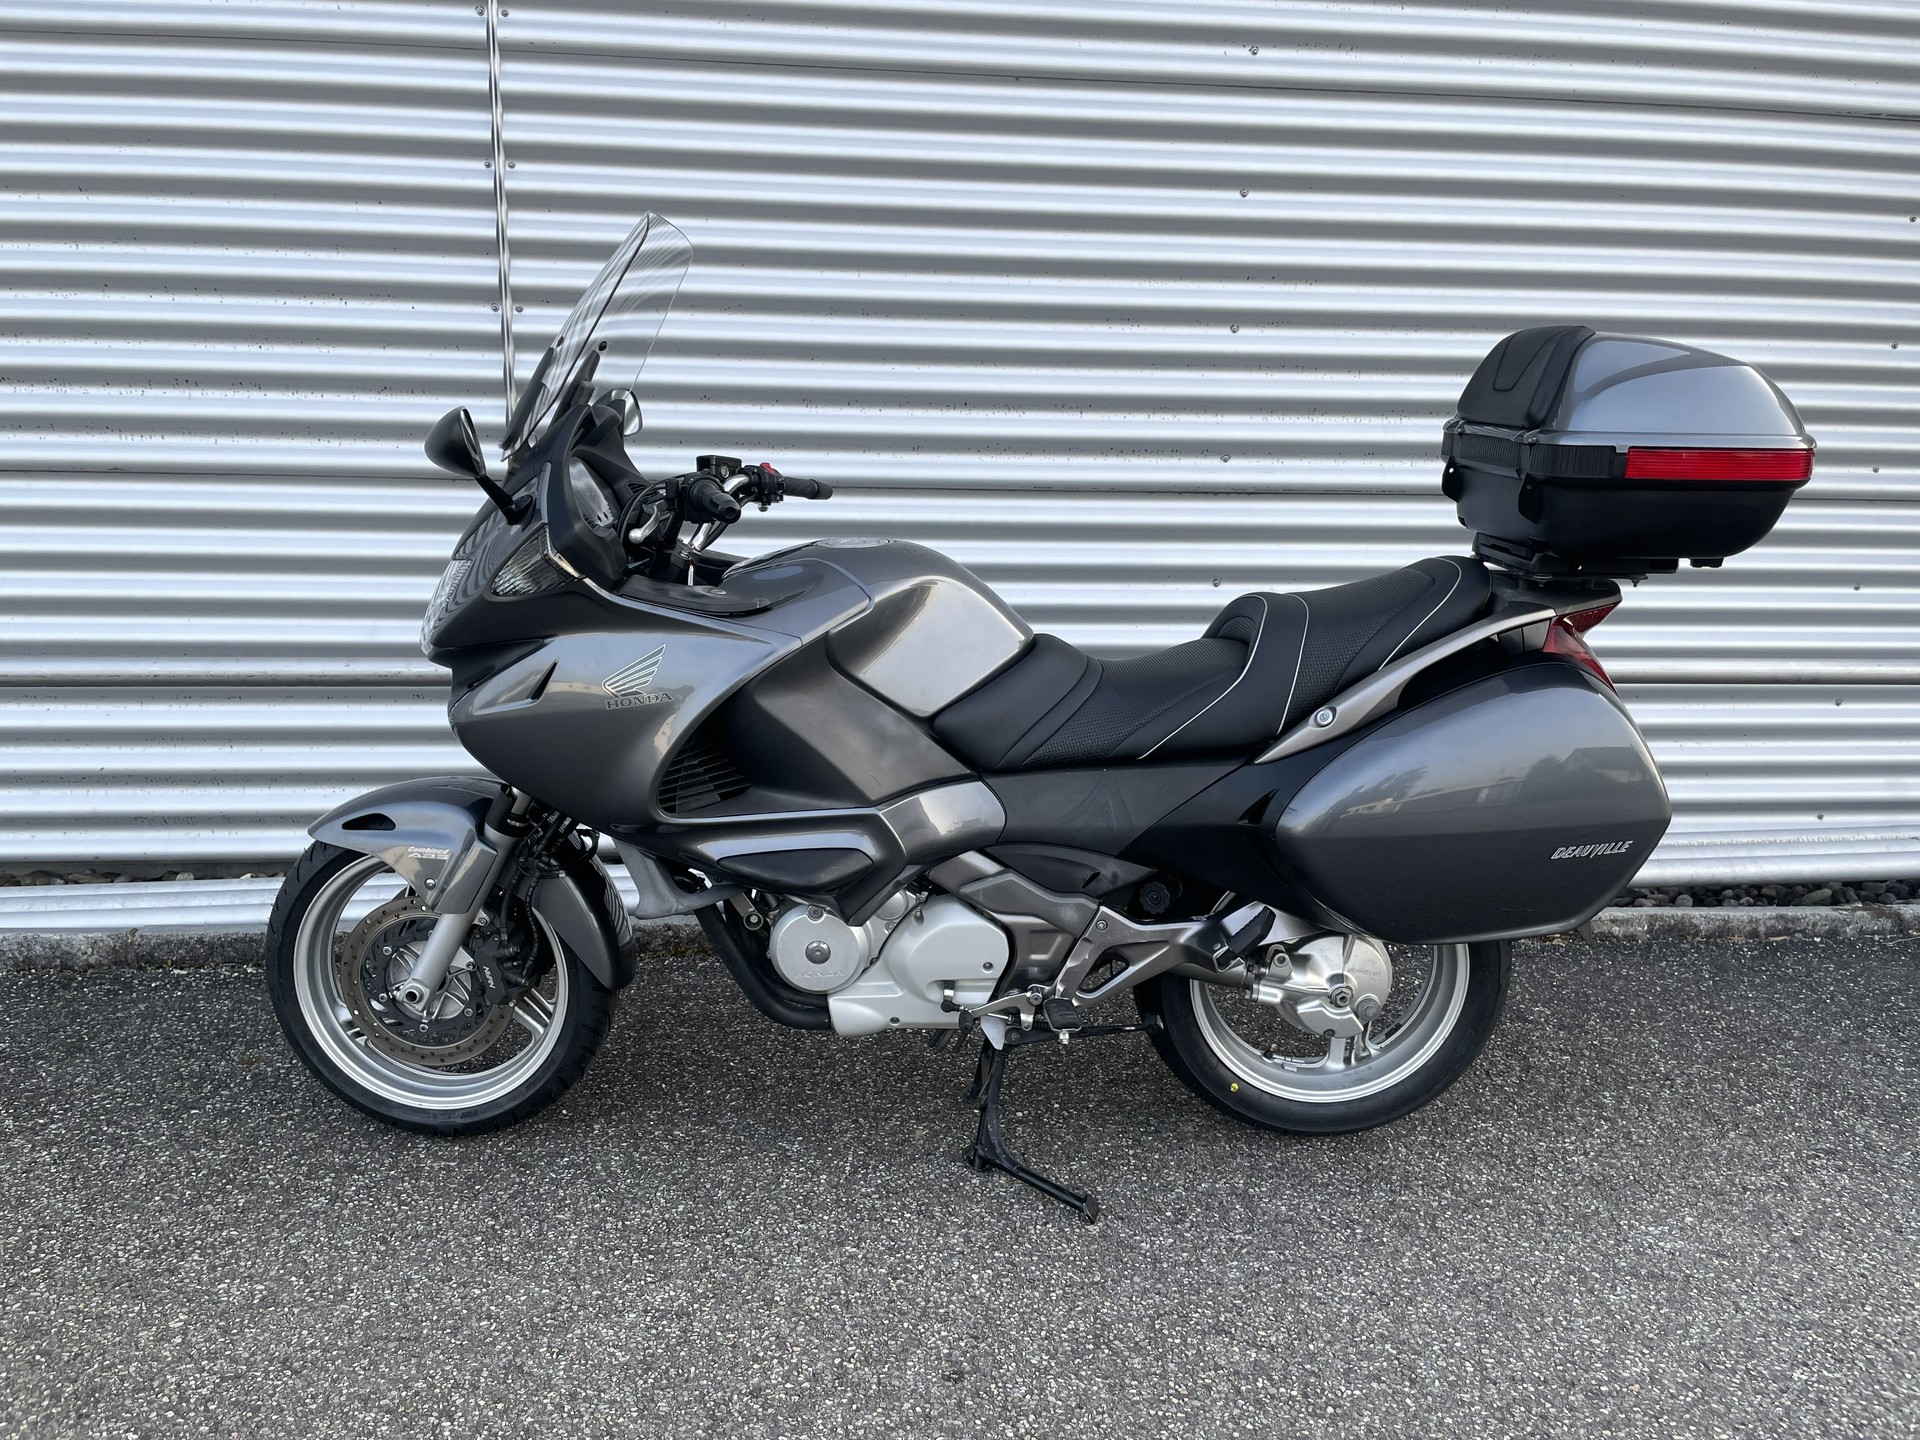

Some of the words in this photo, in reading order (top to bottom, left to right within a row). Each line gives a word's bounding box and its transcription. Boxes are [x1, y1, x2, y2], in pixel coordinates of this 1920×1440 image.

[606, 692, 674, 710] HONDA
[407, 845, 450, 855] Combined
[1550, 840, 1634, 860] DEAUVILLE
